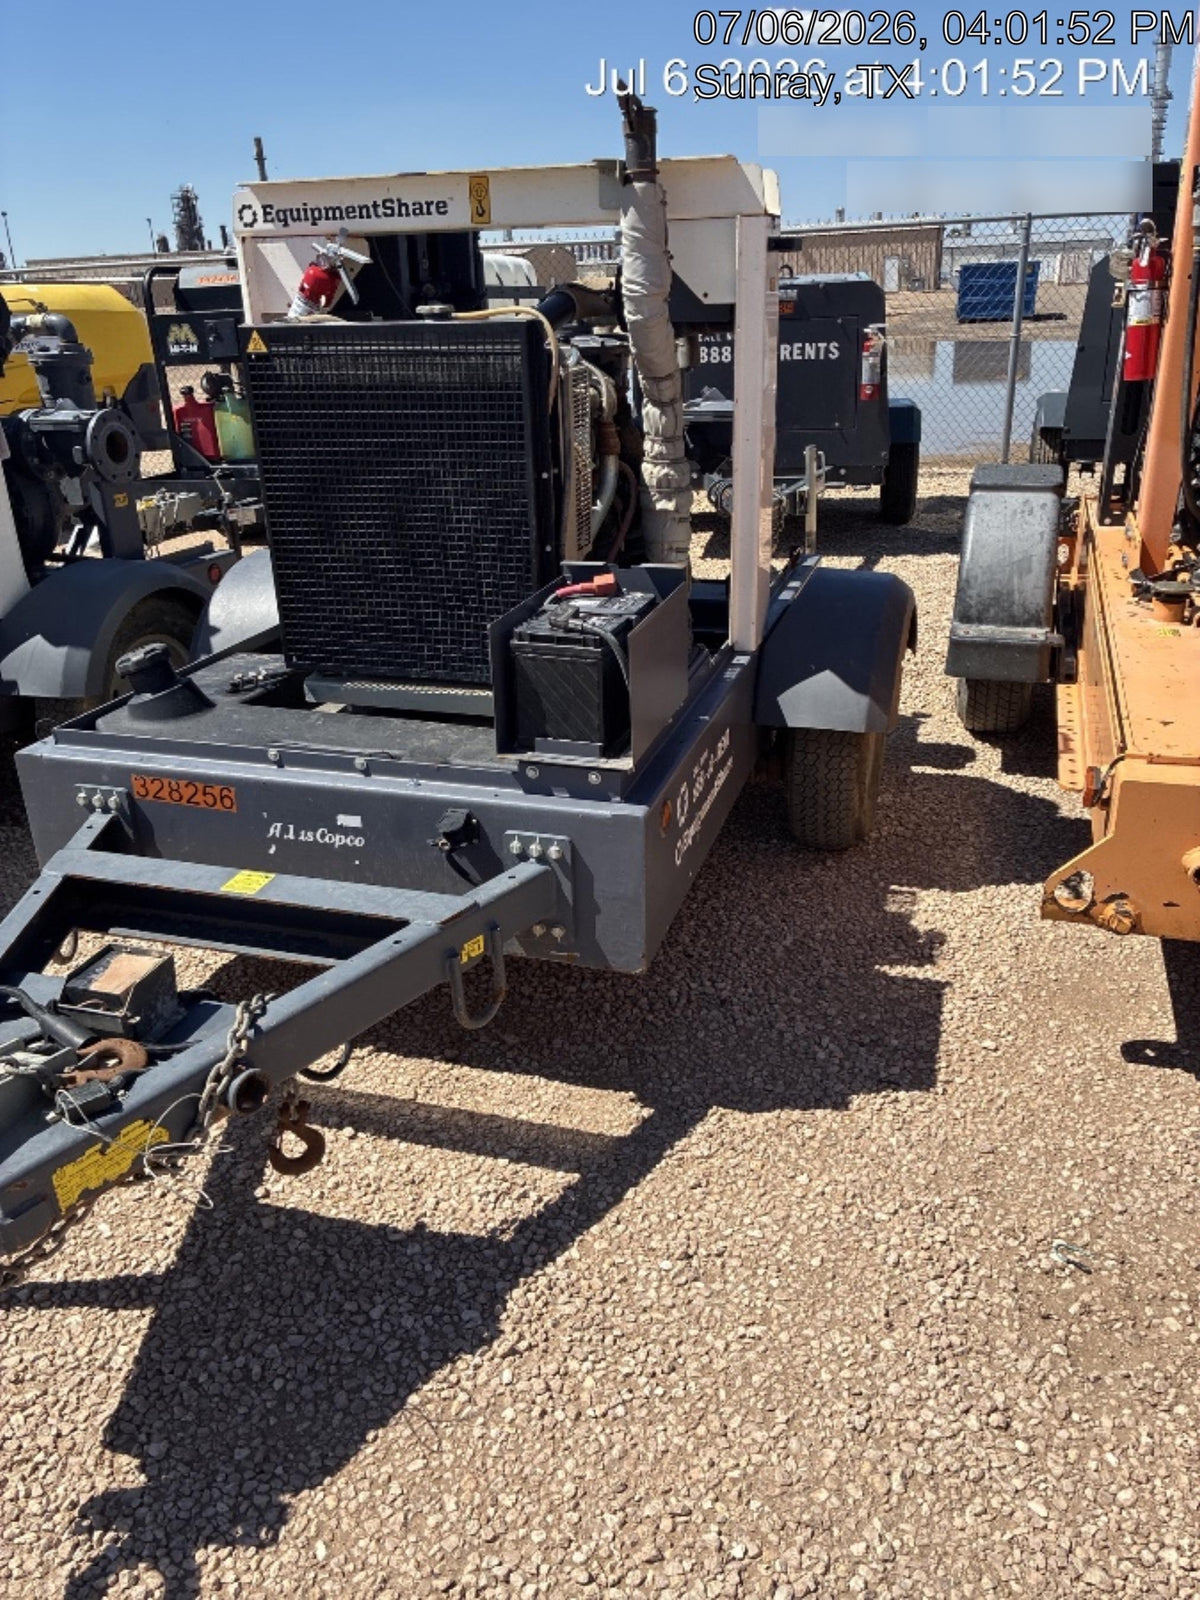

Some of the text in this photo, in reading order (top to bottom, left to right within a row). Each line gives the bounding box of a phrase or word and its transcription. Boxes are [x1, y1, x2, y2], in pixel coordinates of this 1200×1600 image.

[261, 197, 450, 228] EquipmentShare
[779, 341, 840, 361] RENTS
[135, 776, 234, 811] 328256
